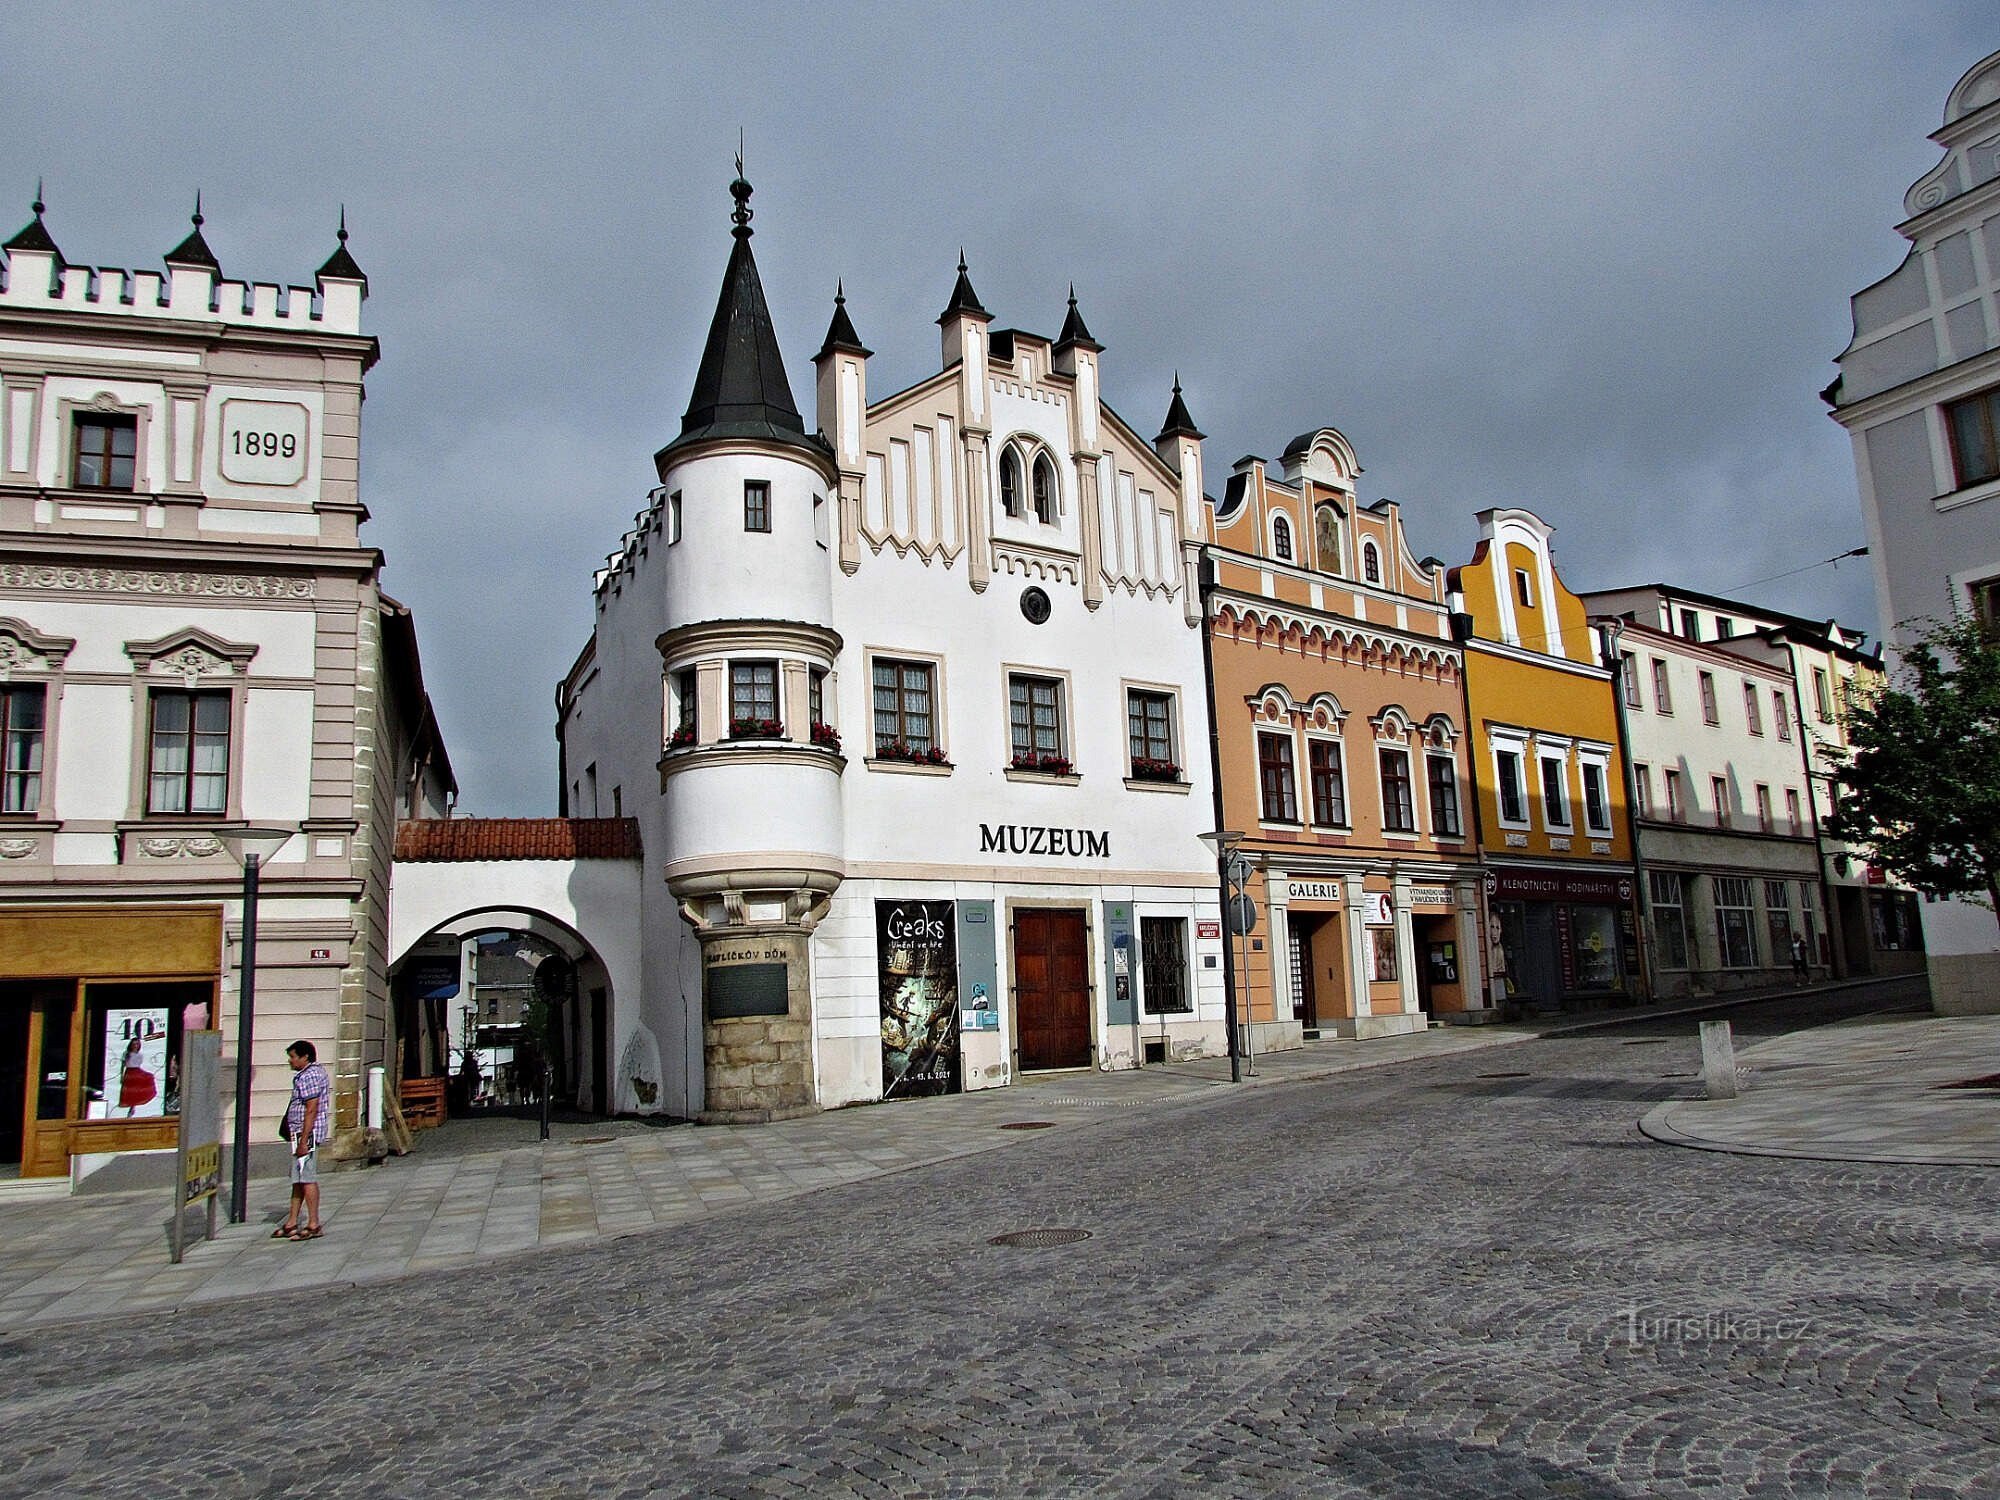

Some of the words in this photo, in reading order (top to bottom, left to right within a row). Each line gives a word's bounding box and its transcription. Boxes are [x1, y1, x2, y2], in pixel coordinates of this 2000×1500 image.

[232, 430, 296, 458] 1899
[979, 824, 1111, 857] MUZEUM
[1289, 883, 1338, 897] GALERIE
[888, 904, 944, 939] Creaks
